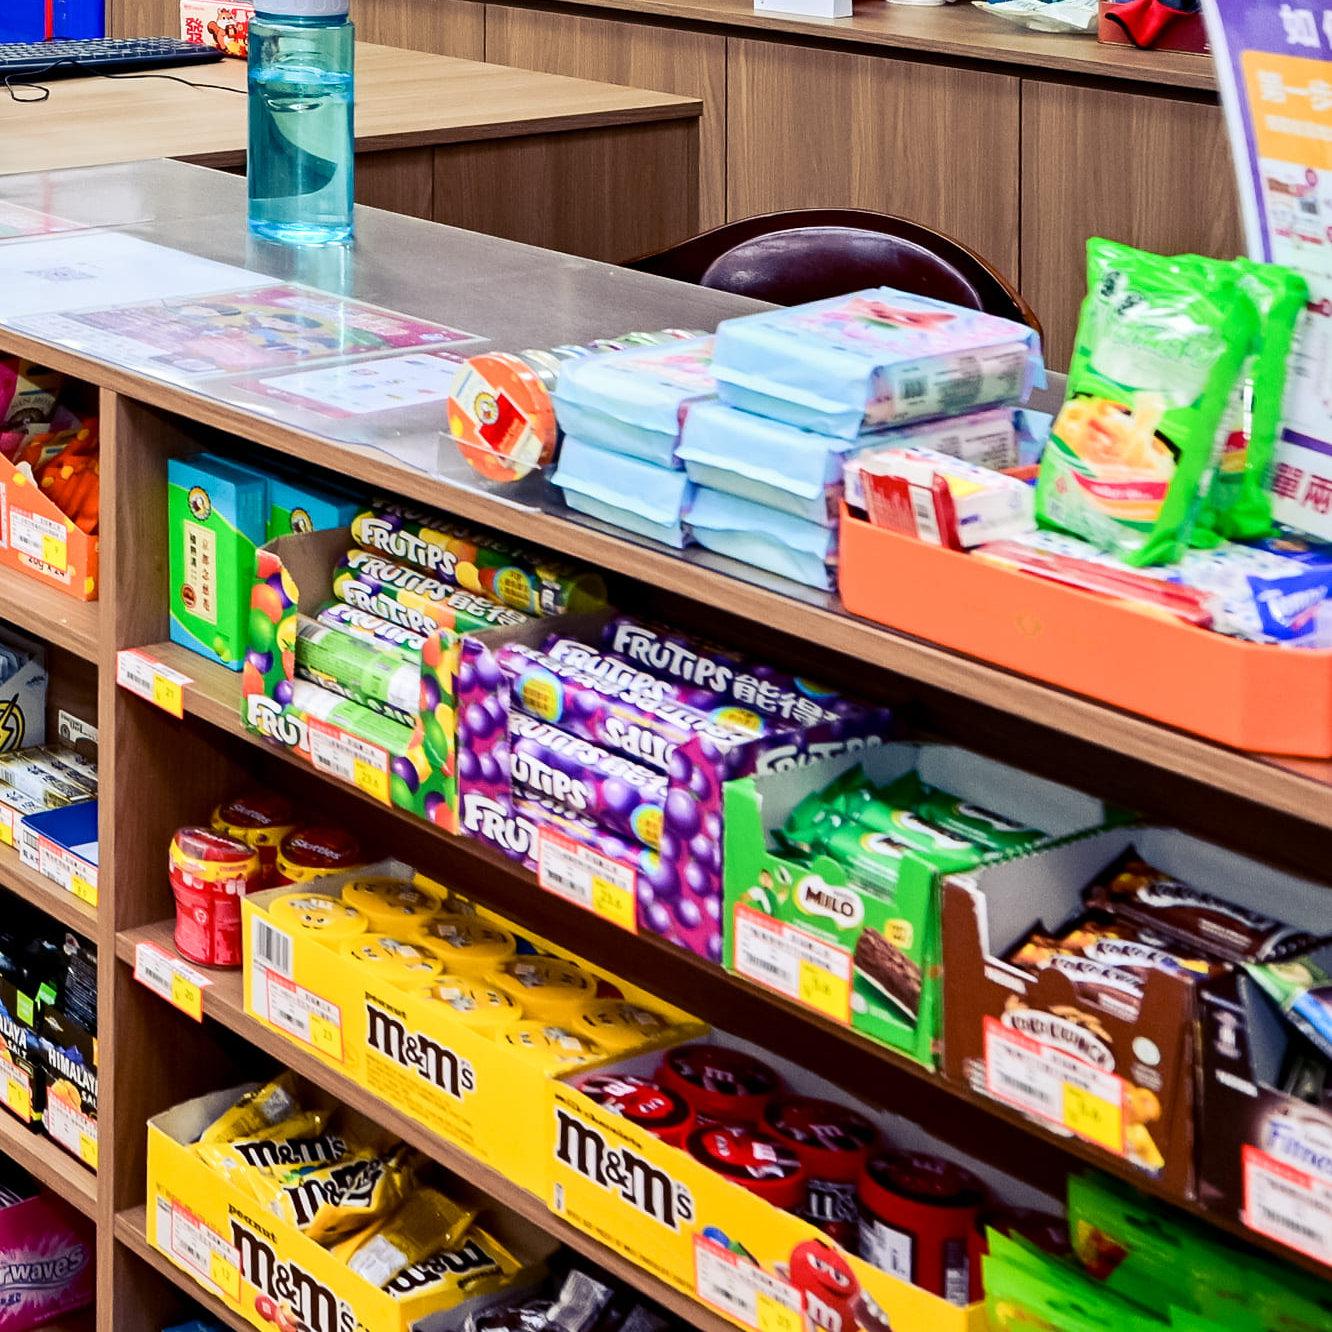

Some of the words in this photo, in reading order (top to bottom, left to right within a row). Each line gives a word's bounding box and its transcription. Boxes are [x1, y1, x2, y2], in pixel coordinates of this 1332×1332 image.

[360, 518, 458, 574] FRUTIPS
[349, 552, 454, 602] FRUTIPS
[342, 580, 439, 637] FRUTIPS
[548, 639, 673, 704] FRUTIPS
[613, 625, 734, 693] FRUTIPS
[804, 886, 856, 918] MILO
[365, 990, 407, 1020] peanut
[7, 1040, 27, 1059] SALT
[227, 1201, 279, 1243] peanut
